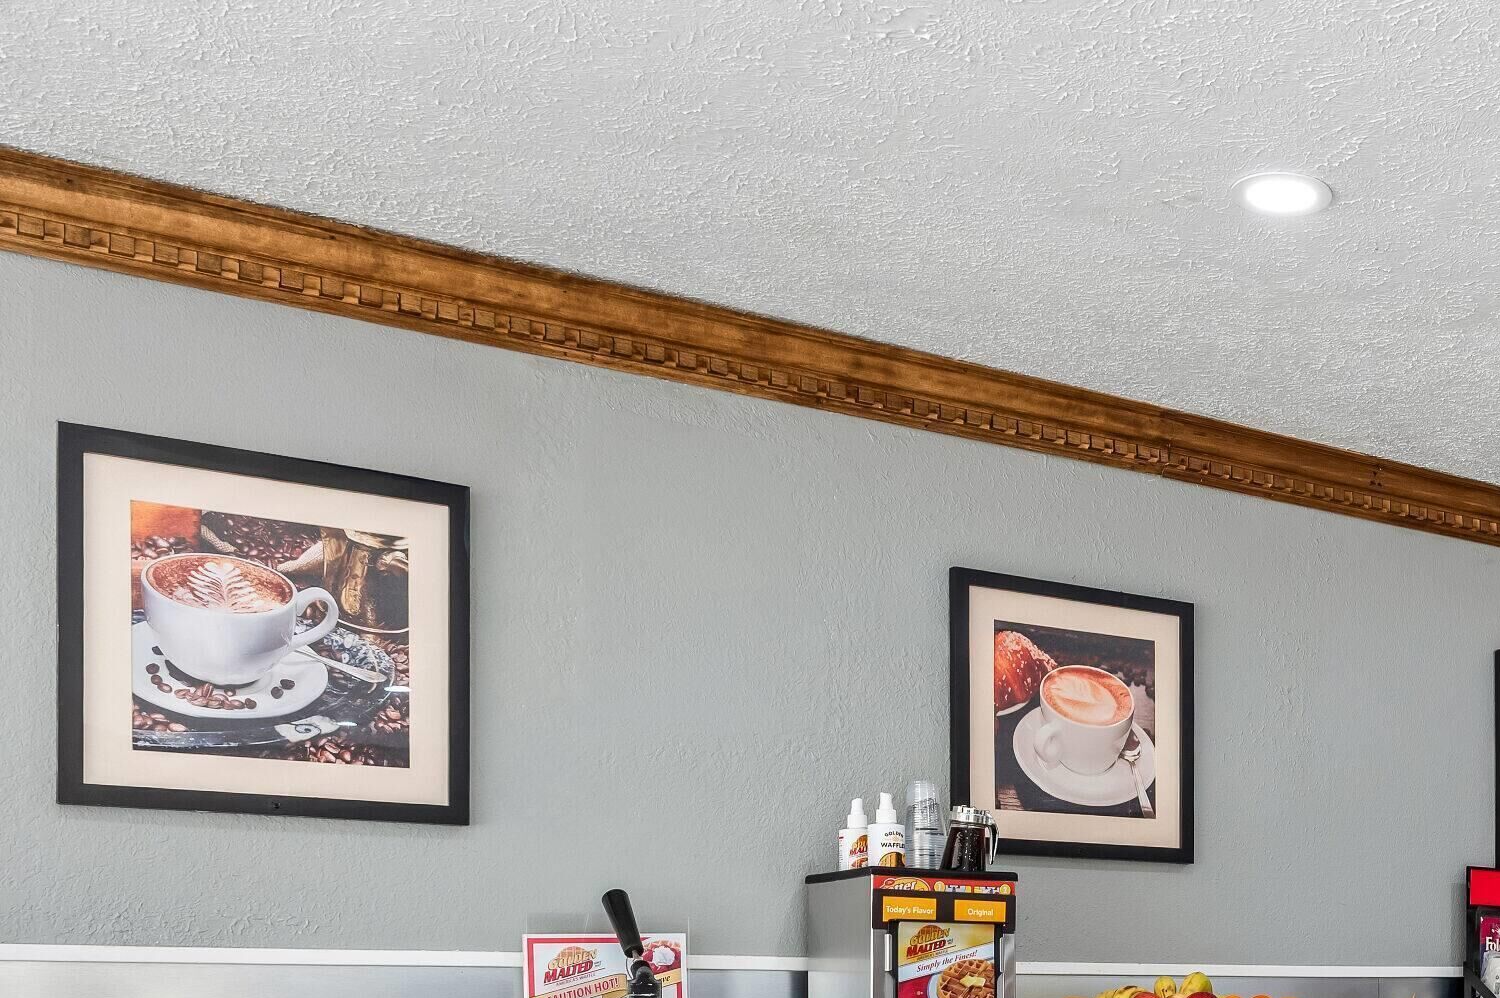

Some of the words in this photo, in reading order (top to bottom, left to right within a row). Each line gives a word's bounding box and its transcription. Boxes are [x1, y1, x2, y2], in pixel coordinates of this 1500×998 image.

[886, 906, 911, 914] Today's
[967, 908, 994, 916] Original
[910, 928, 950, 946] GOLDEN
[906, 939, 946, 957] MALTED
[547, 948, 597, 970] GOLDEN
[916, 960, 941, 972] Simply
[941, 955, 953, 965] the
[954, 950, 978, 961] Finest!
[543, 959, 594, 984] MALTED
[594, 977, 620, 993] HOT!
